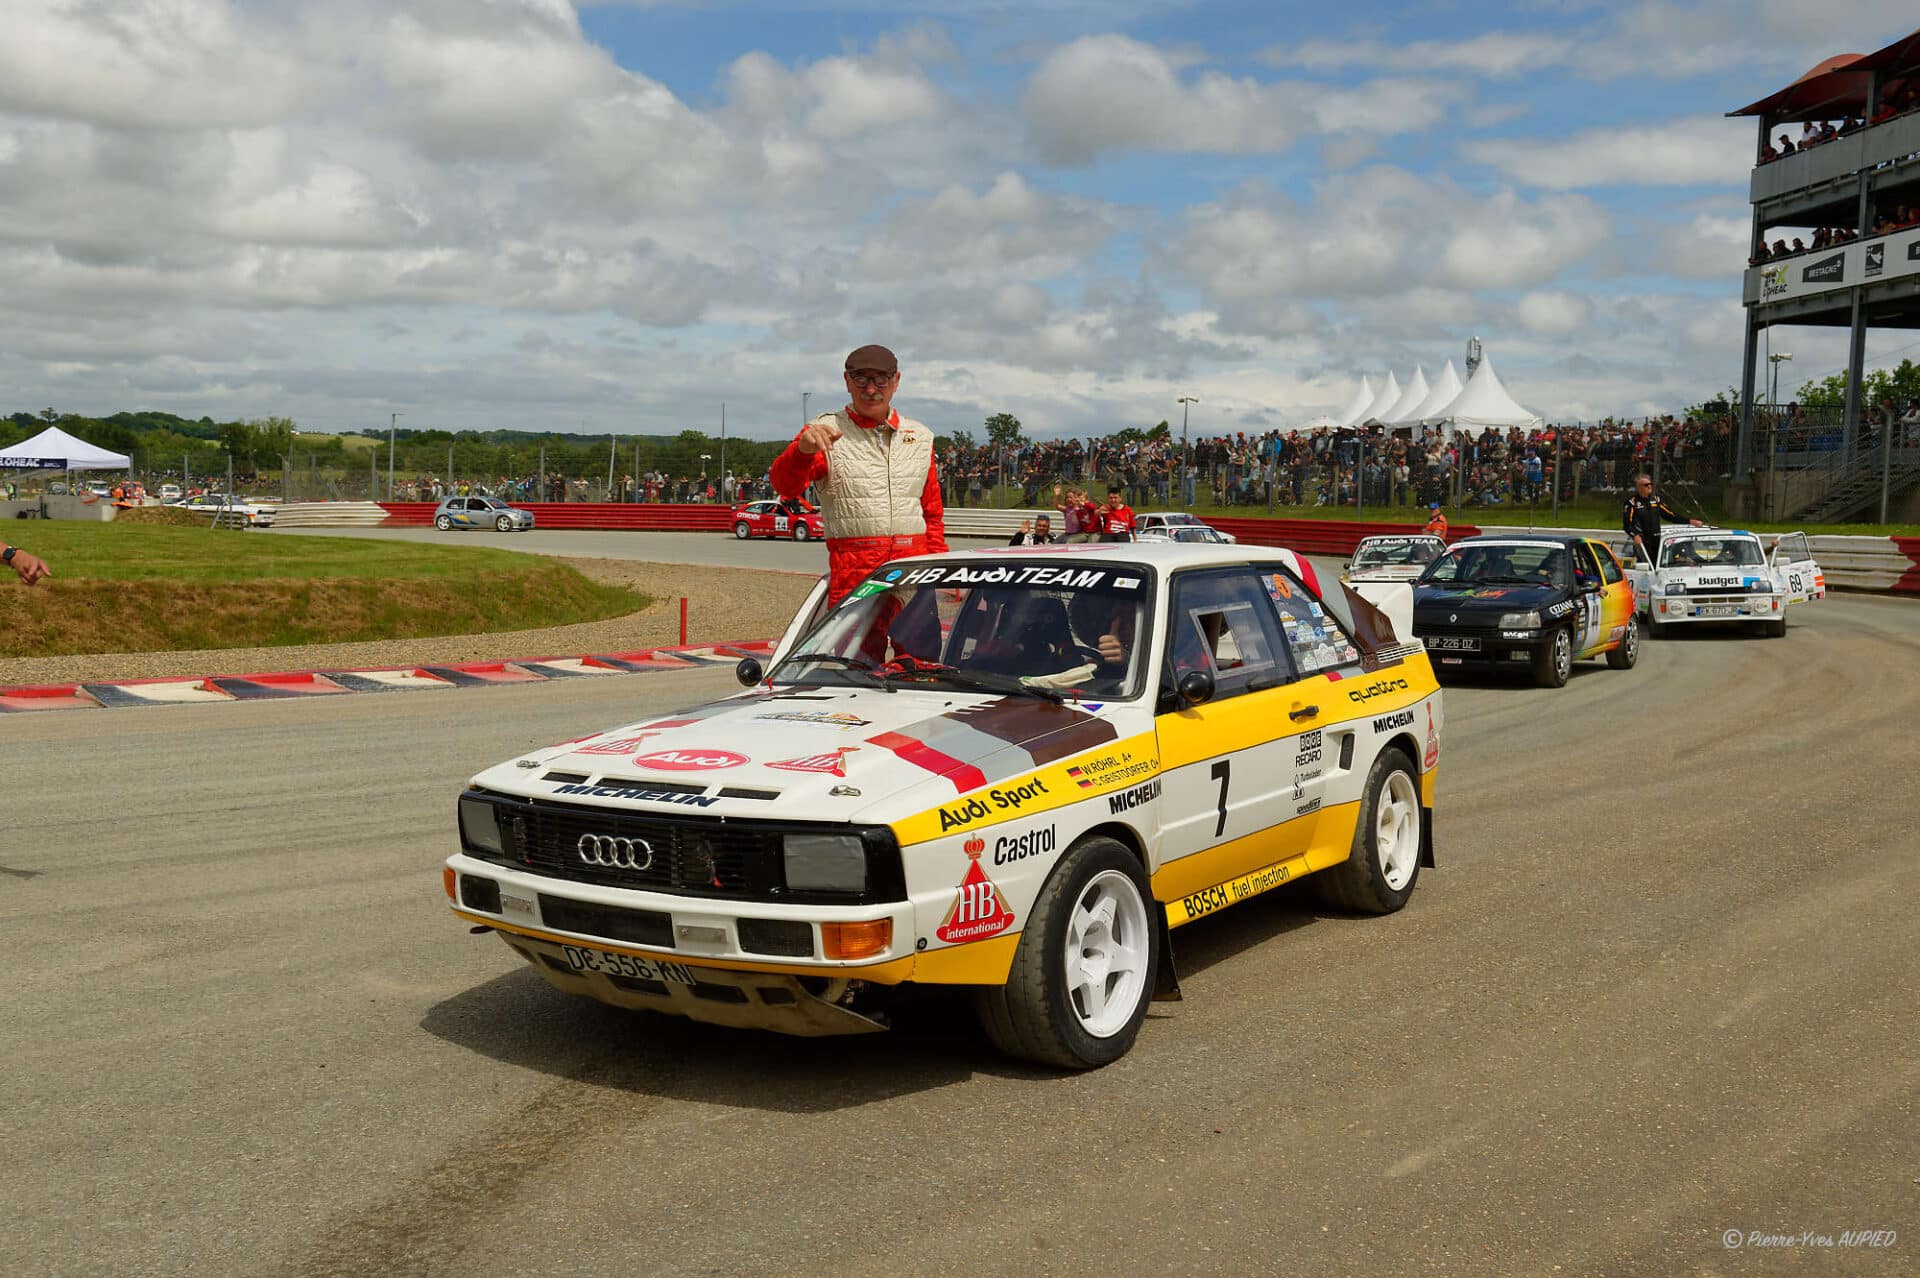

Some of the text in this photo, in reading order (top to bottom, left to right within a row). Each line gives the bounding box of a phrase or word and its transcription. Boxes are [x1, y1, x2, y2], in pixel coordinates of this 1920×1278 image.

[777, 521, 786, 530] 14
[901, 568, 946, 585] HB
[1013, 567, 1106, 588] TEAM
[1698, 576, 1739, 587] Budget
[1788, 574, 1803, 593] 69
[1349, 678, 1408, 703] quattro
[1373, 710, 1415, 734] MICHELIN
[1299, 730, 1322, 752] BOGE
[658, 752, 738, 766] Audi
[1295, 749, 1322, 767] RECARO
[552, 783, 720, 808] MICHELIN
[939, 777, 1049, 832] Audi Sport
[1108, 778, 1162, 815] MICHELIN
[1211, 760, 1230, 838] 7
[994, 824, 1056, 866] Castrol
[955, 880, 997, 924] HB
[1184, 865, 1290, 918] BOSCH fuel injection
[946, 917, 1004, 940] international
